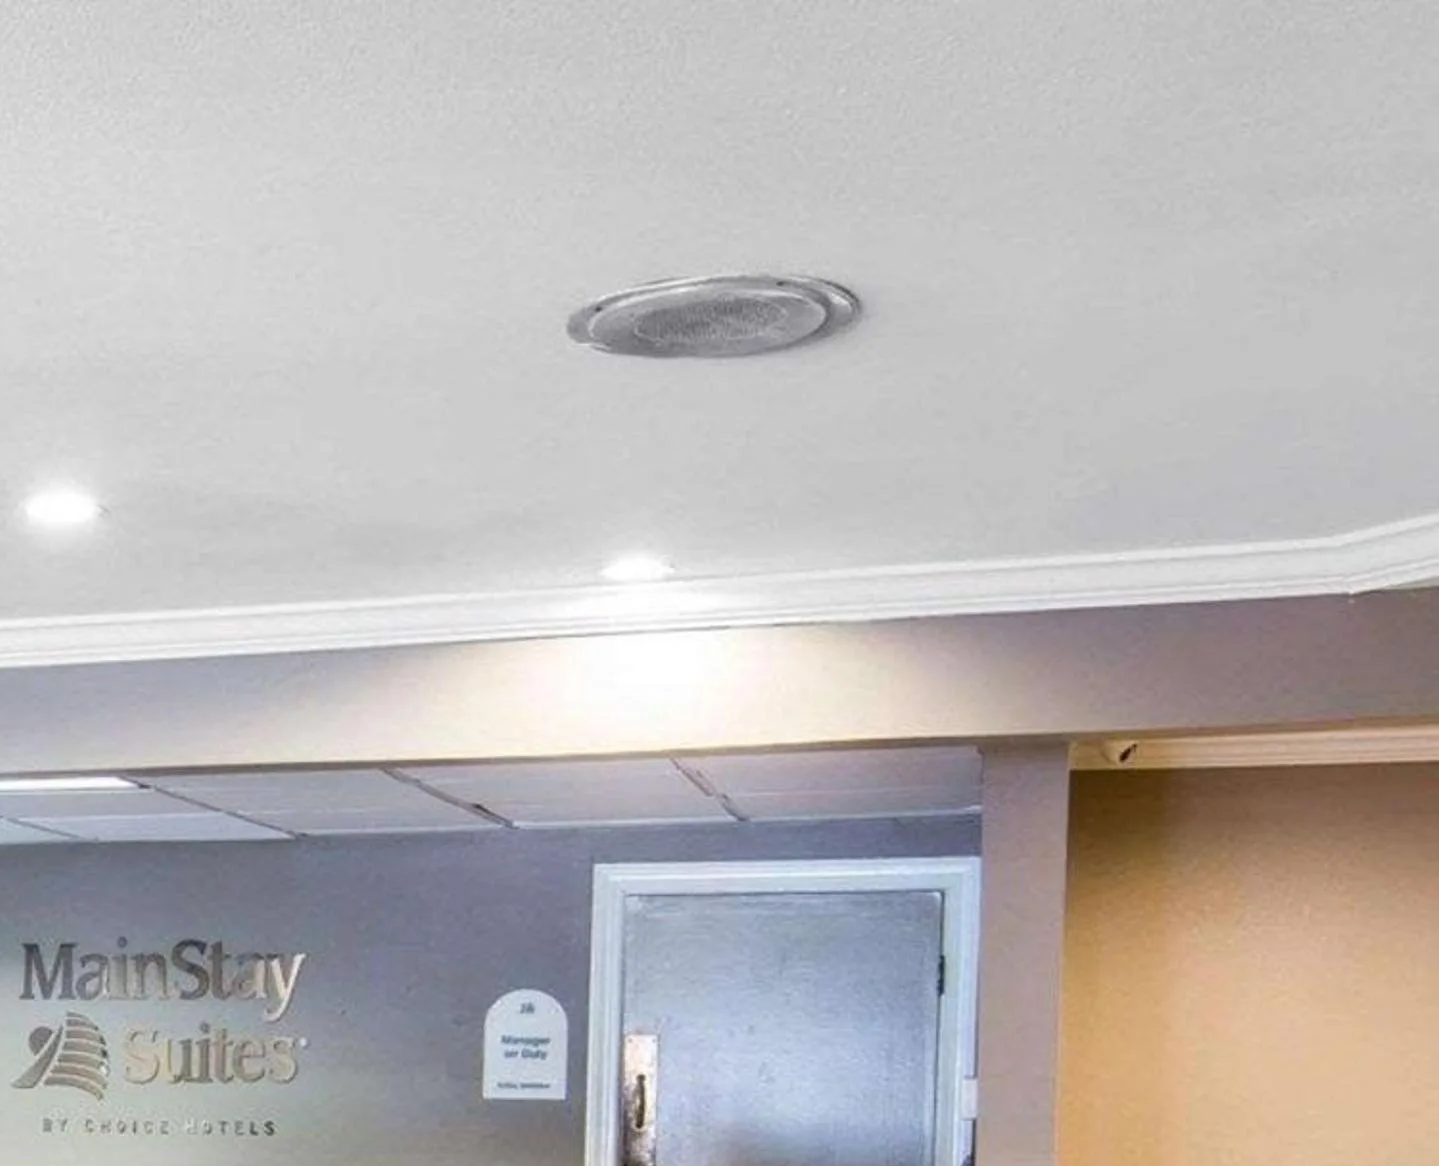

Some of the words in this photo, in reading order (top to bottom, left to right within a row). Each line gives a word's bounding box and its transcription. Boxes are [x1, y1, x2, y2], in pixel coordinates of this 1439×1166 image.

[19, 936, 307, 1022] MainStay
[122, 1021, 300, 1086] Suites
[43, 1117, 68, 1133] BY
[83, 1118, 170, 1135] CHOICE
[186, 1119, 276, 1136] HOTELS
